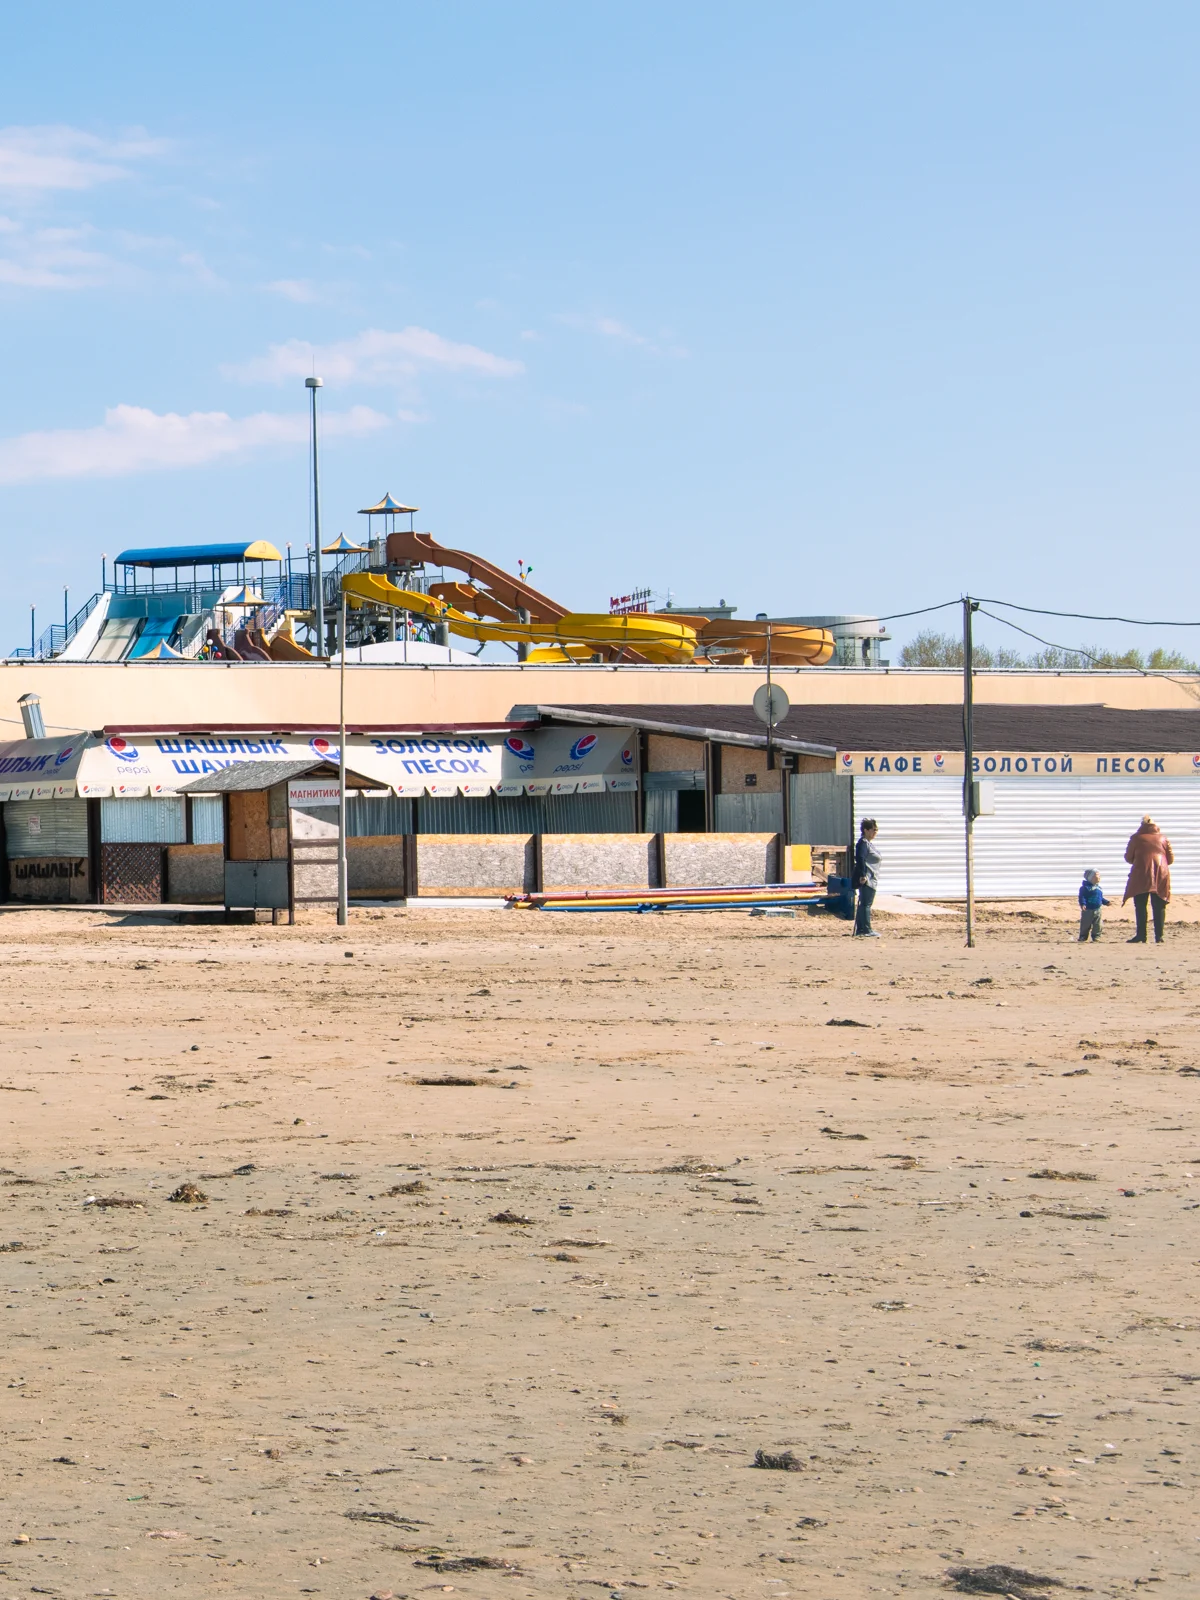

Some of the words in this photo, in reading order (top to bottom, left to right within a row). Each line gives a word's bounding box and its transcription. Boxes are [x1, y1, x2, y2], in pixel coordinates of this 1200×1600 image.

[155, 739, 289, 754] ШАШЛЫК
[370, 736, 492, 754] ЗОЛОТОЙ
[117, 765, 151, 775] pepsi
[401, 759, 488, 774] ПЕСОК
[553, 762, 584, 774] pepsi
[864, 756, 922, 772] КАФЕ
[972, 754, 1072, 772] ЗОЛОТОЙ
[1096, 758, 1165, 773] ПЕСОК
[290, 788, 340, 799] МАГНИТИКИ
[15, 857, 86, 879] ШАШЛЫК
